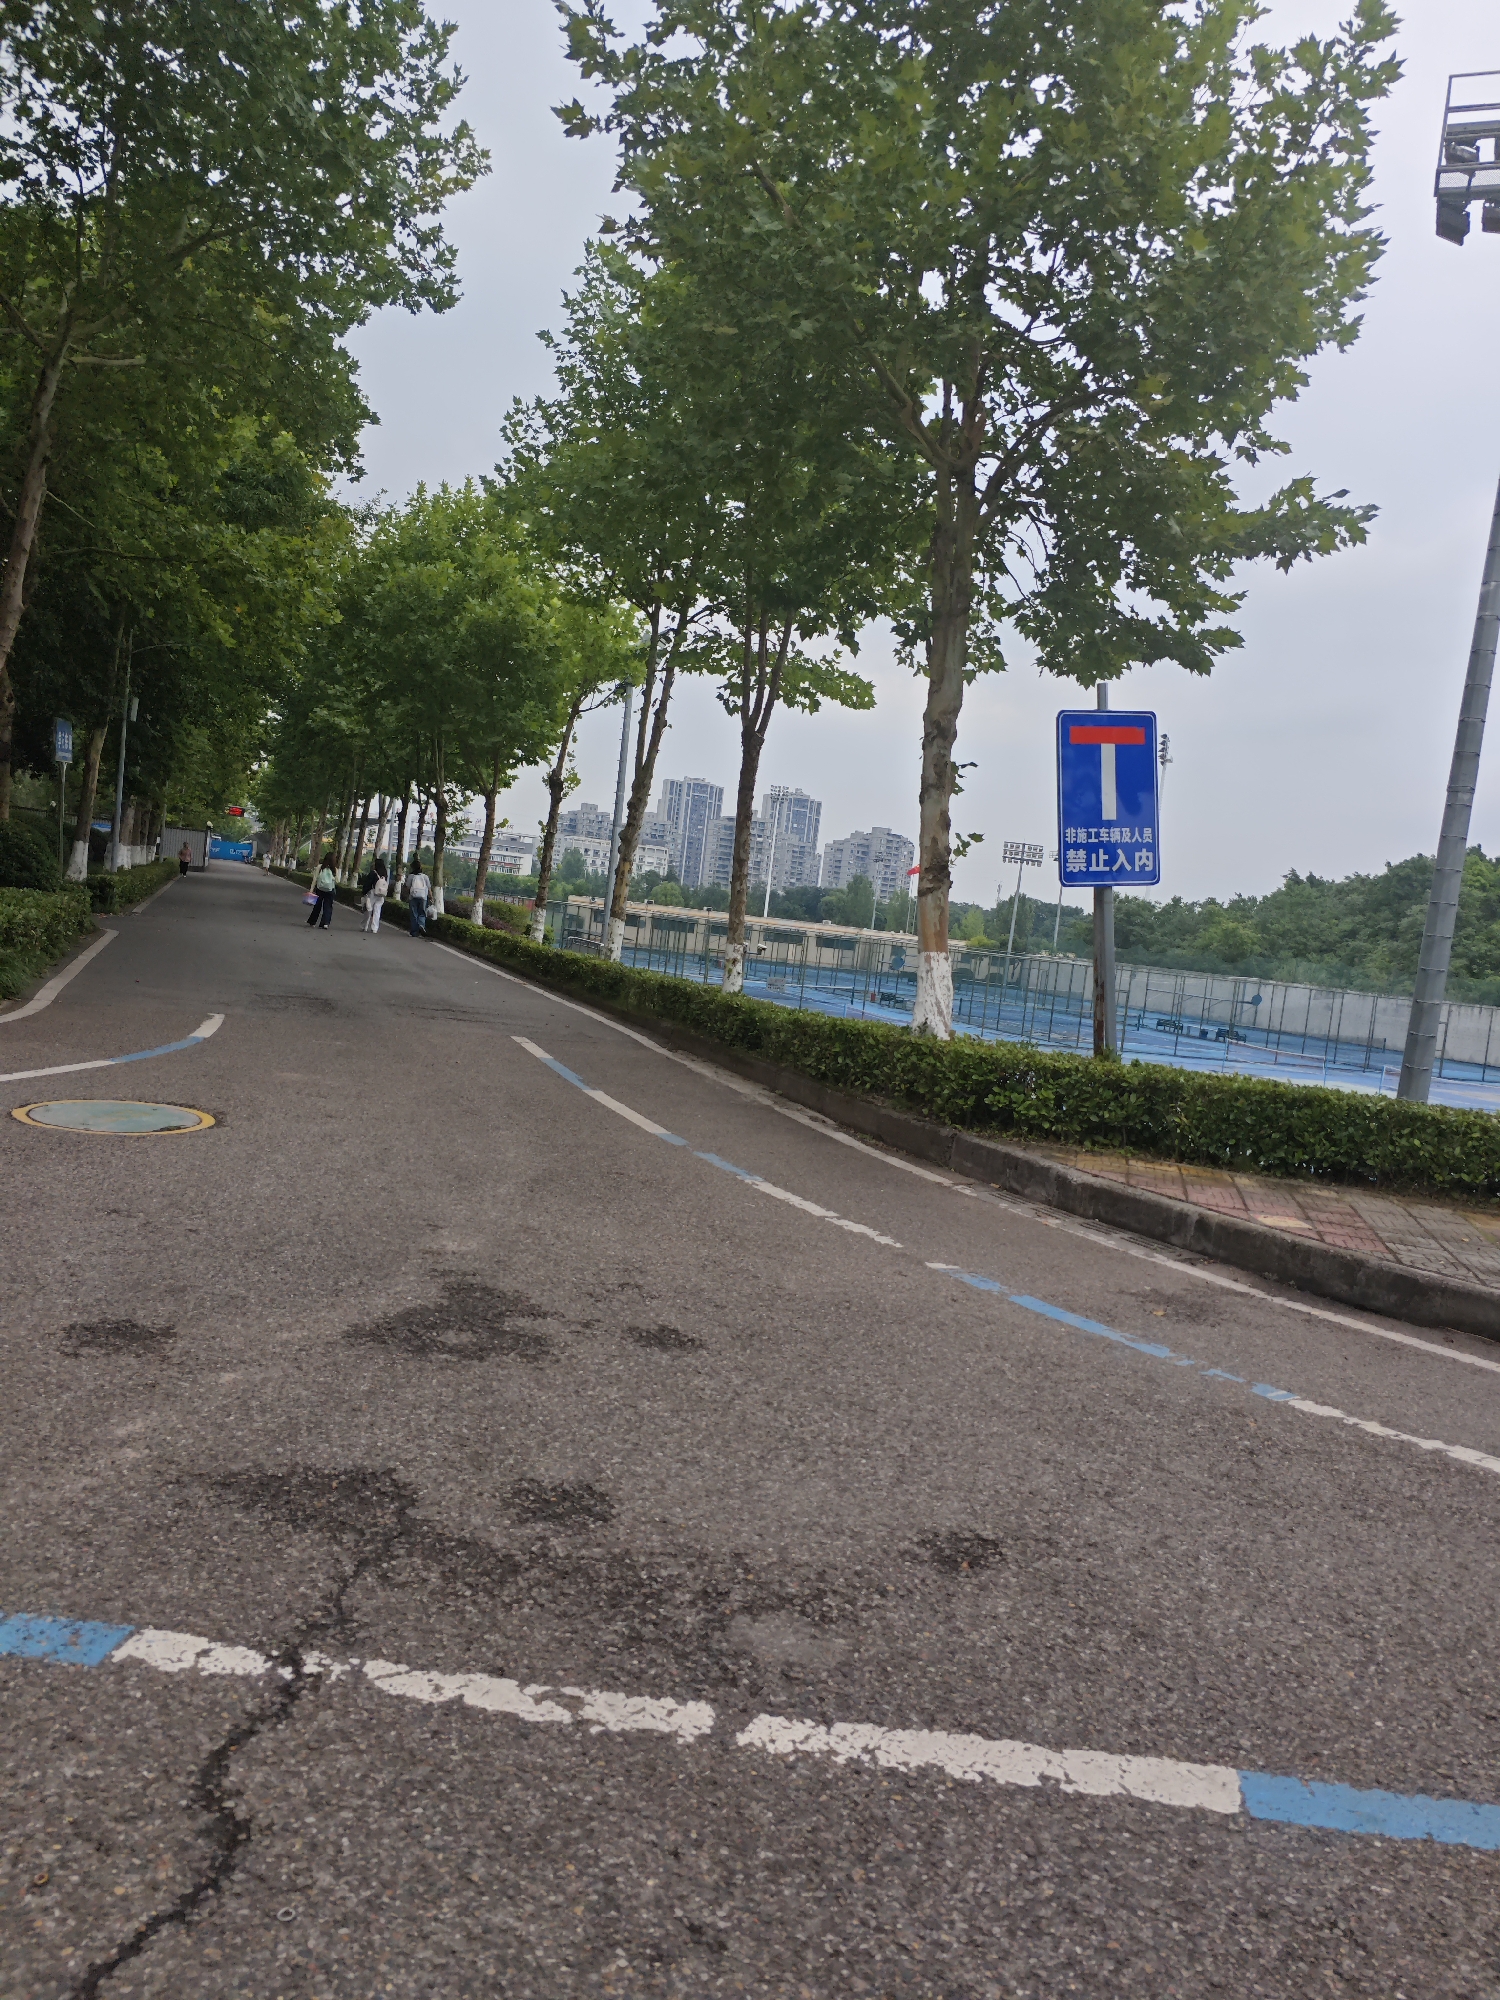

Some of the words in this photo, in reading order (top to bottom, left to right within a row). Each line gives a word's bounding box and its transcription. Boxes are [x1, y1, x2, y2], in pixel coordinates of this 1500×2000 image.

[1065, 827, 1153, 844] 非施工车辆及人员
[1066, 848, 1154, 873] 禁止入内
